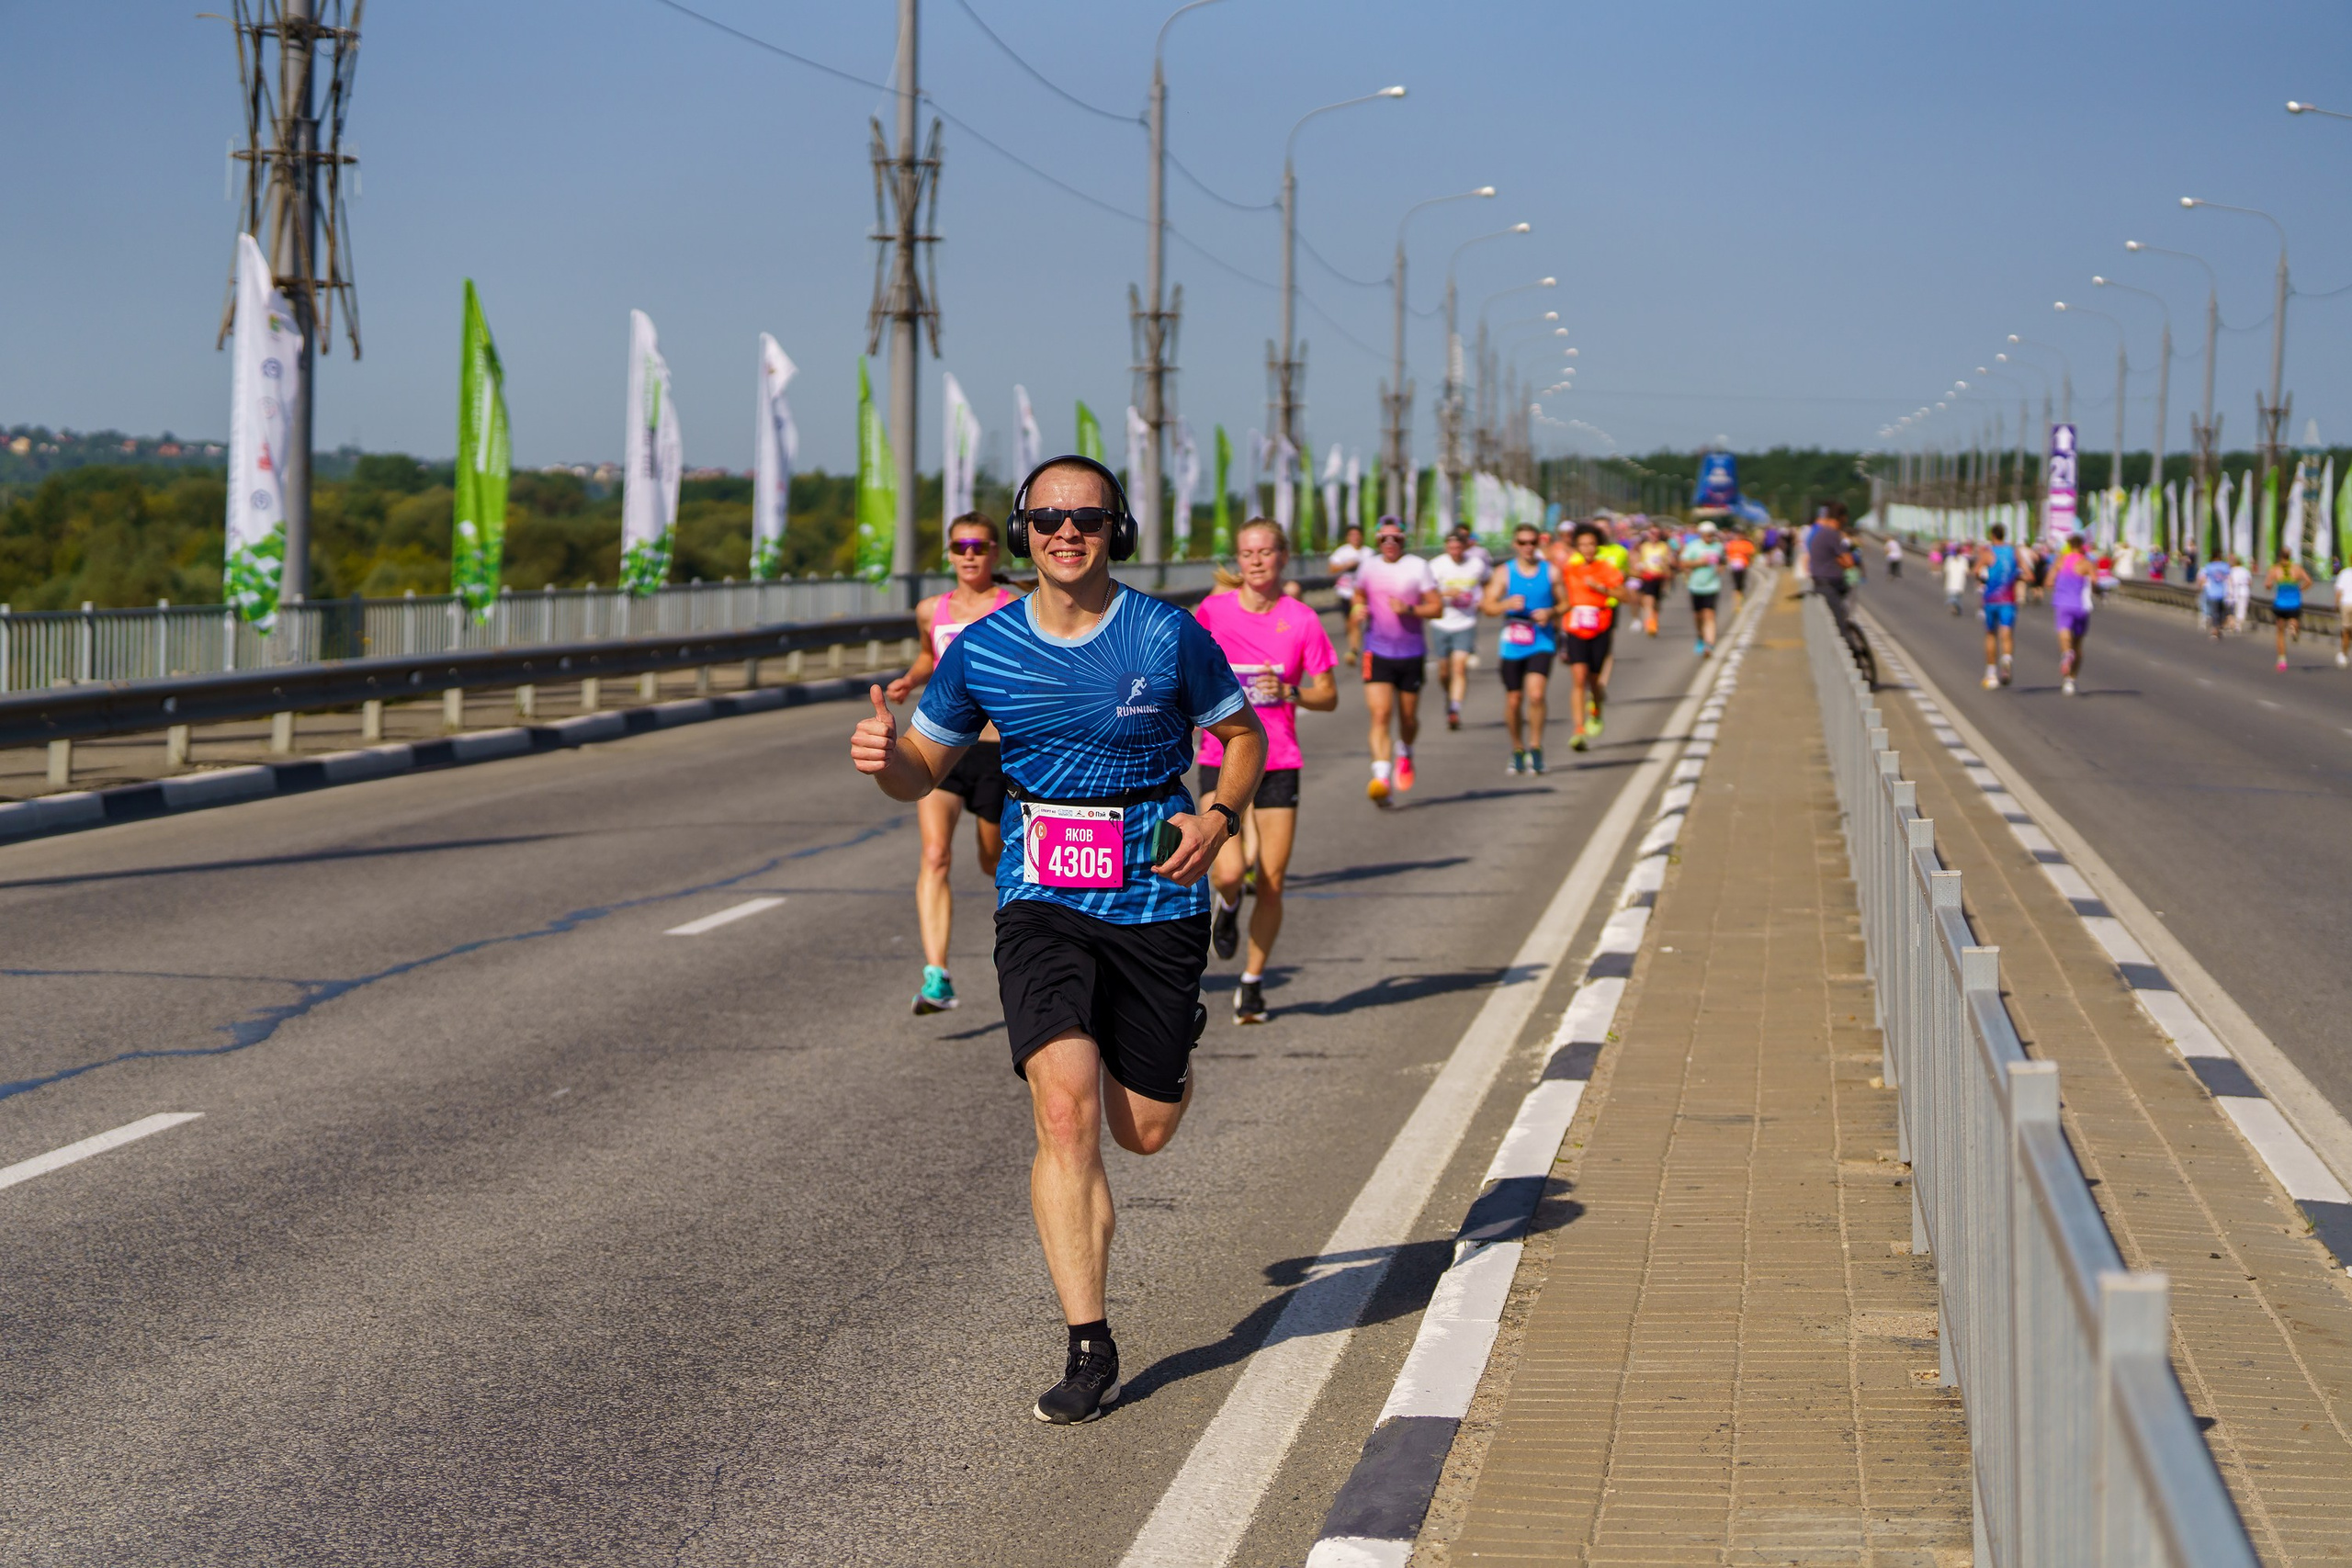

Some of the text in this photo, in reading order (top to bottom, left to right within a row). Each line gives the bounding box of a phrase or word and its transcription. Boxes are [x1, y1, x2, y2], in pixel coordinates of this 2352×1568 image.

[1116, 704, 1159, 717] RUNNING
[1065, 828, 1093, 842] ЯКОВ
[1048, 845, 1113, 878] 4305
